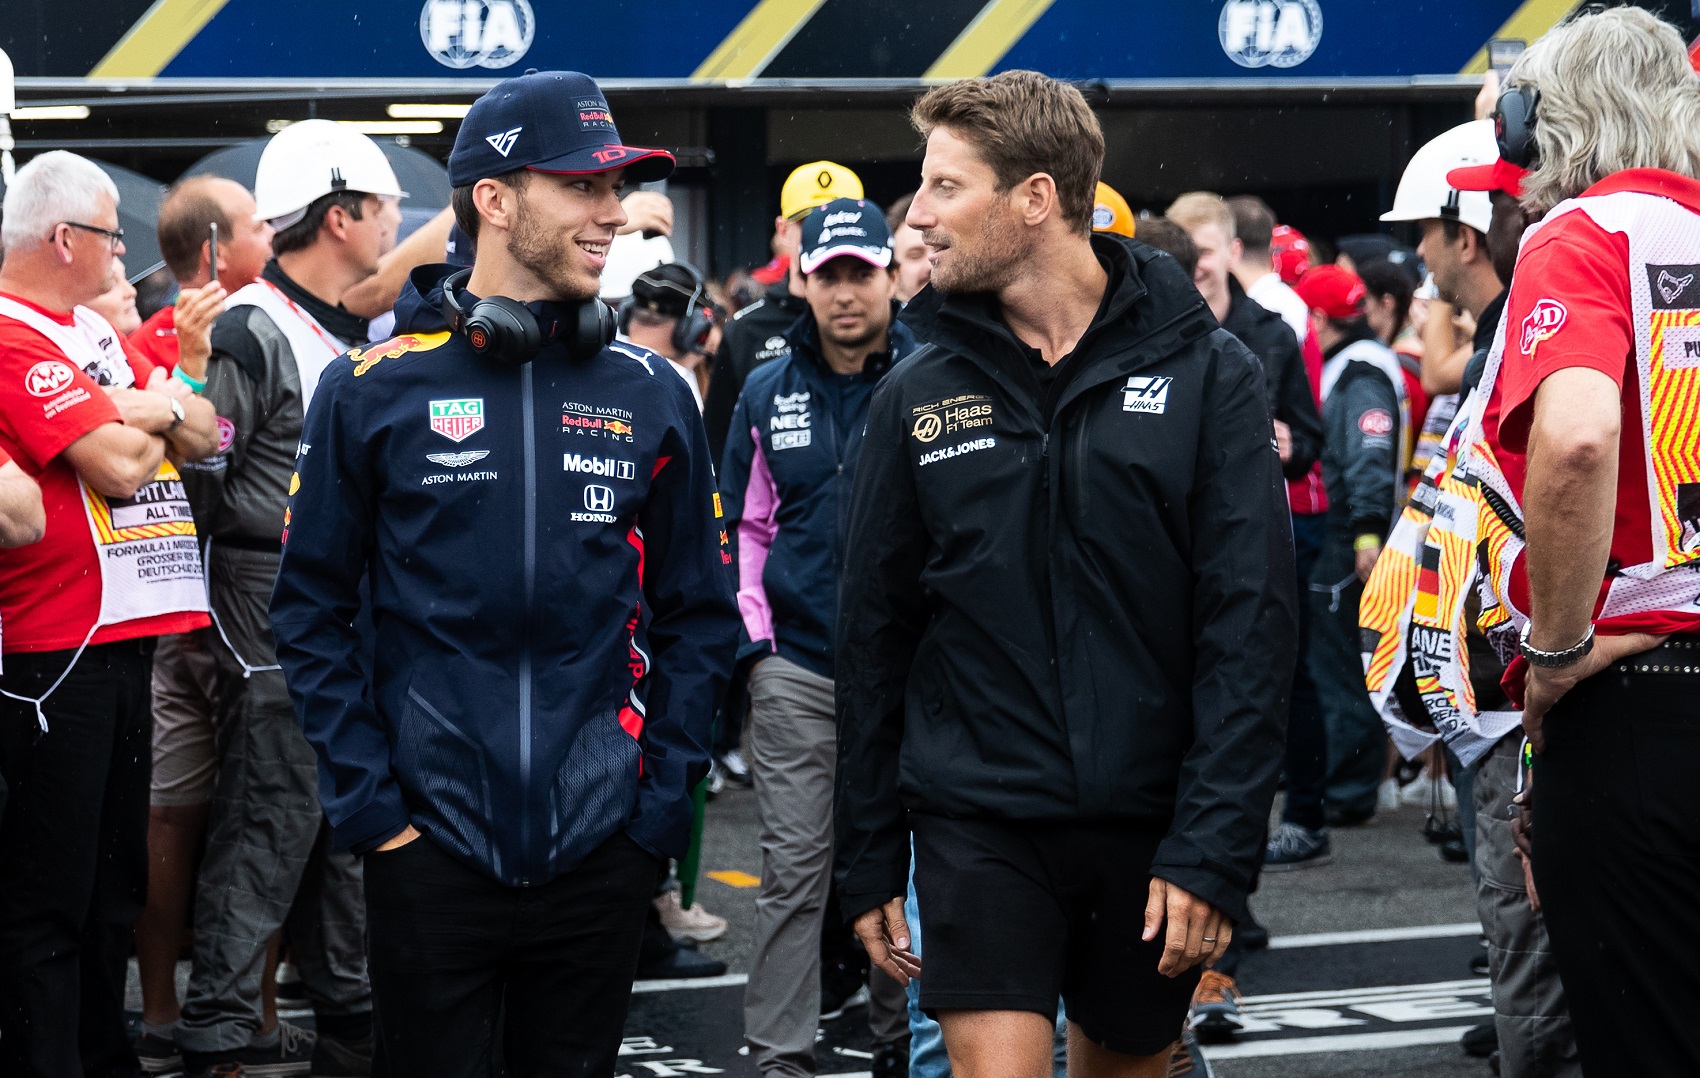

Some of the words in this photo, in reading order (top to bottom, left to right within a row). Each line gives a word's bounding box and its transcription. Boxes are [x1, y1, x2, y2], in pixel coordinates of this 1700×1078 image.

[428, 0, 524, 52] FIA
[1226, 0, 1313, 52] FIA
[582, 121, 617, 131] RACIN
[592, 149, 627, 164] 10
[434, 402, 479, 416] TAG
[562, 401, 593, 414] ASTON
[596, 406, 633, 420] MARTIN
[912, 402, 940, 414] RICH
[945, 404, 993, 425] Haas
[433, 417, 481, 439] HEUER
[770, 412, 812, 431] NEC
[946, 421, 960, 435] F1
[959, 416, 993, 430] Team
[562, 426, 634, 443] RACING
[919, 437, 997, 467] JACK&JONES
[563, 453, 616, 478] Mobil
[421, 474, 454, 486] ASTON
[457, 471, 498, 482] MARTIN
[146, 506, 169, 520] ALL
[107, 543, 166, 559] FORMULA
[1411, 626, 1451, 659] ANE
